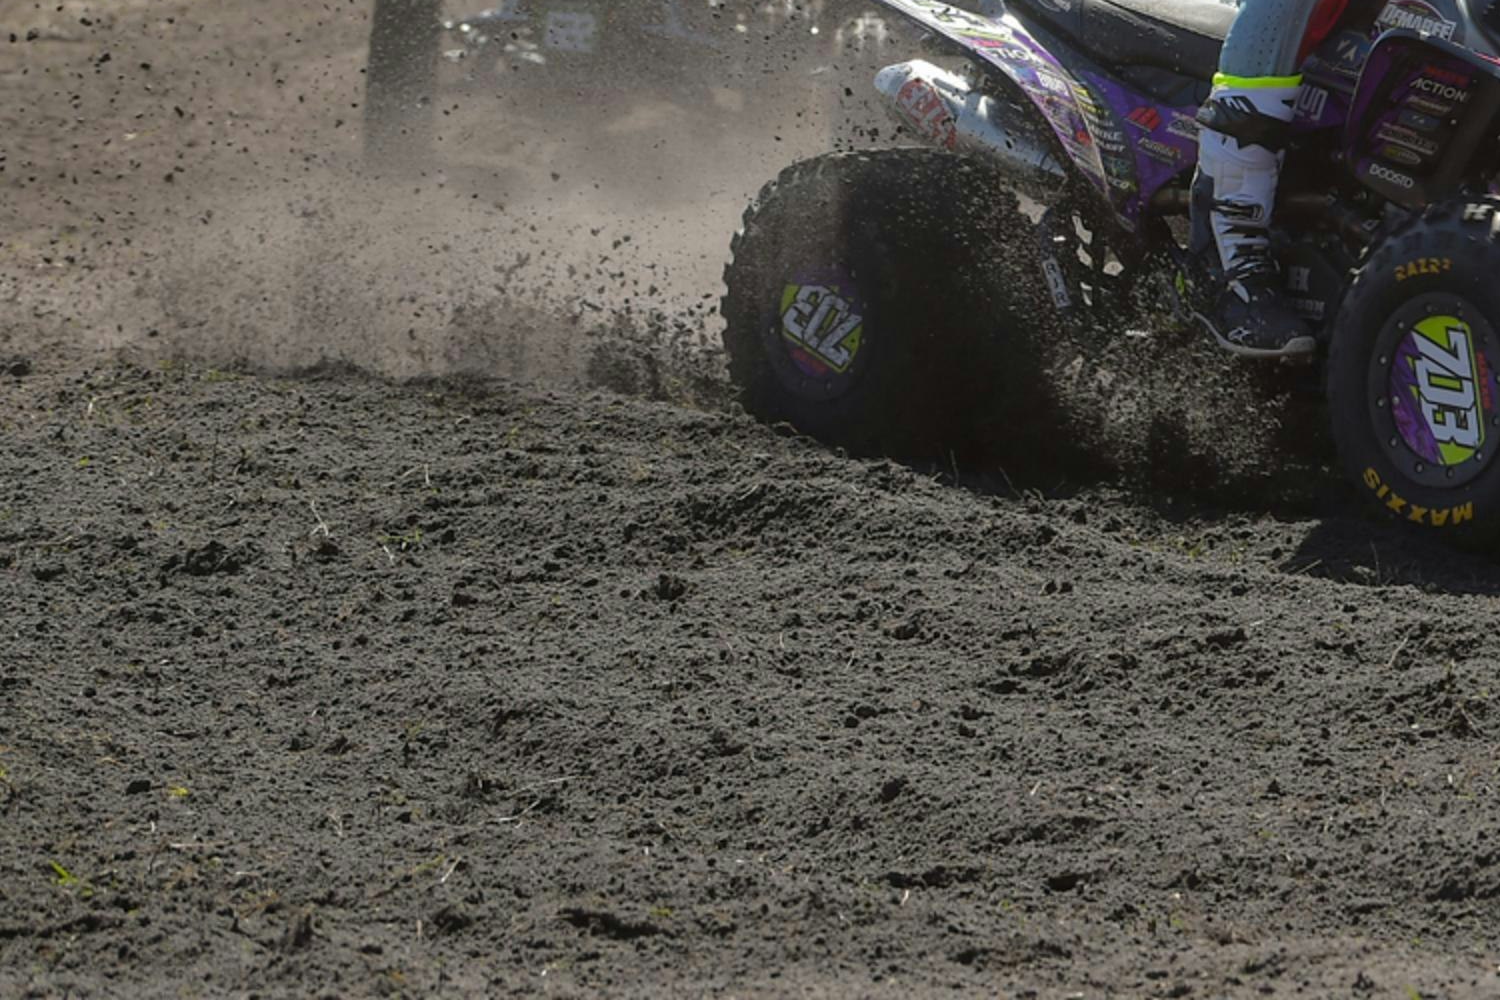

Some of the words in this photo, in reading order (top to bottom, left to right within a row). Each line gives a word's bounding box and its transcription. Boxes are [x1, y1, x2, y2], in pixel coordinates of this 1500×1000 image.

[1410, 78, 1468, 102] ACTION
[782, 284, 863, 366] 703
[1411, 326, 1481, 449] 703
[1362, 466, 1474, 528] MAXXIS
